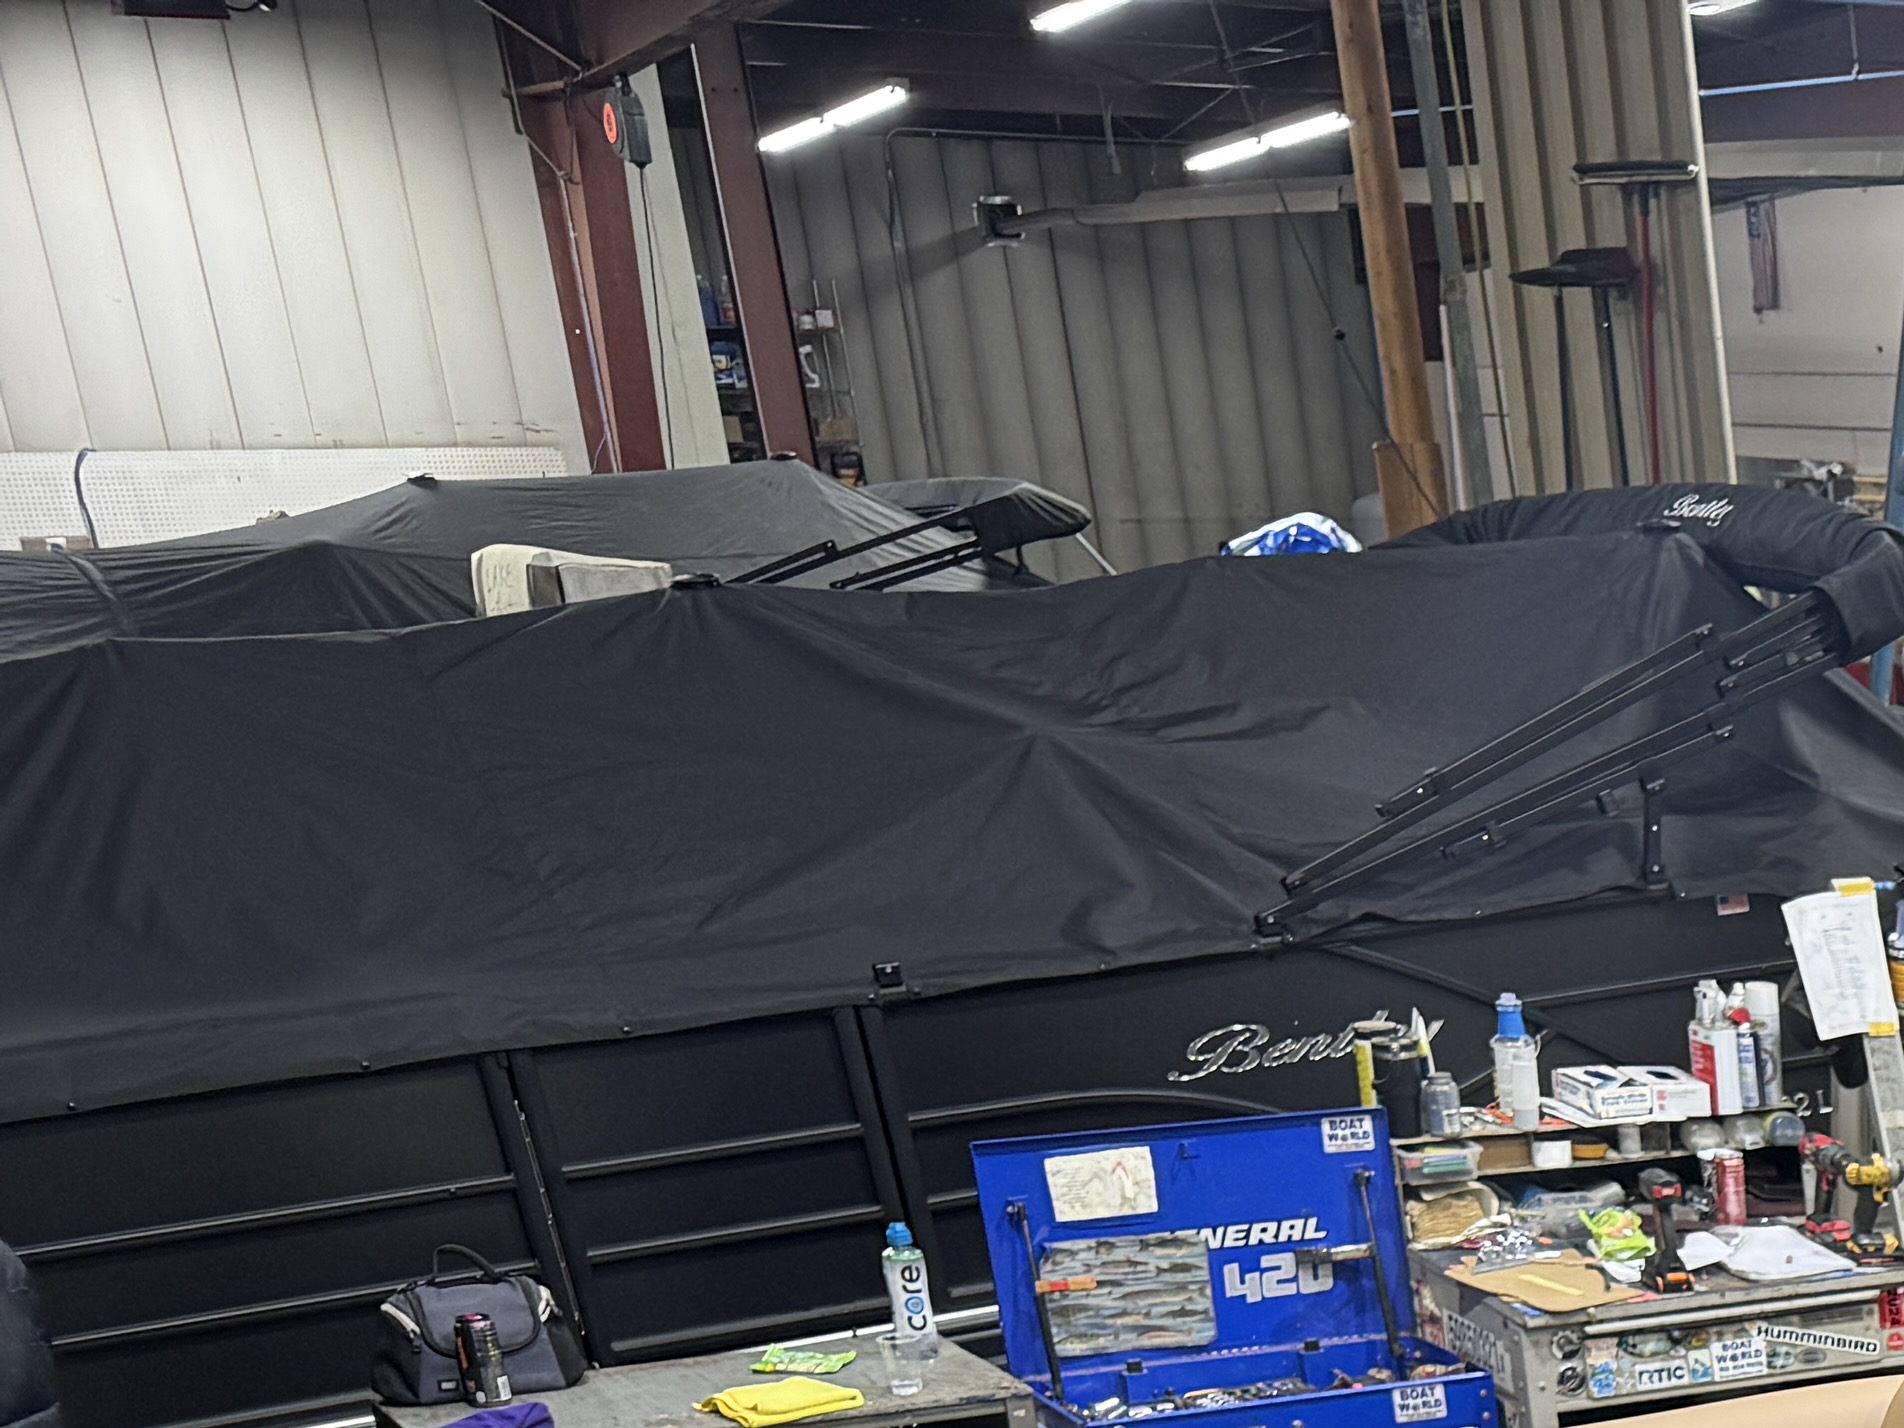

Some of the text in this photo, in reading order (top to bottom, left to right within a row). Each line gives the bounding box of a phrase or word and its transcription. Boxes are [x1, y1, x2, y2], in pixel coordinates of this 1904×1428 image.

[1167, 1008, 1445, 1082] Bent
[1328, 1117, 1365, 1131] BOAT
[900, 1264, 927, 1331] core
[1756, 1325, 1878, 1353] HUMMINBIRD
[1638, 1365, 1686, 1385] RTIC
[1400, 1385, 1436, 1400] BOAT
